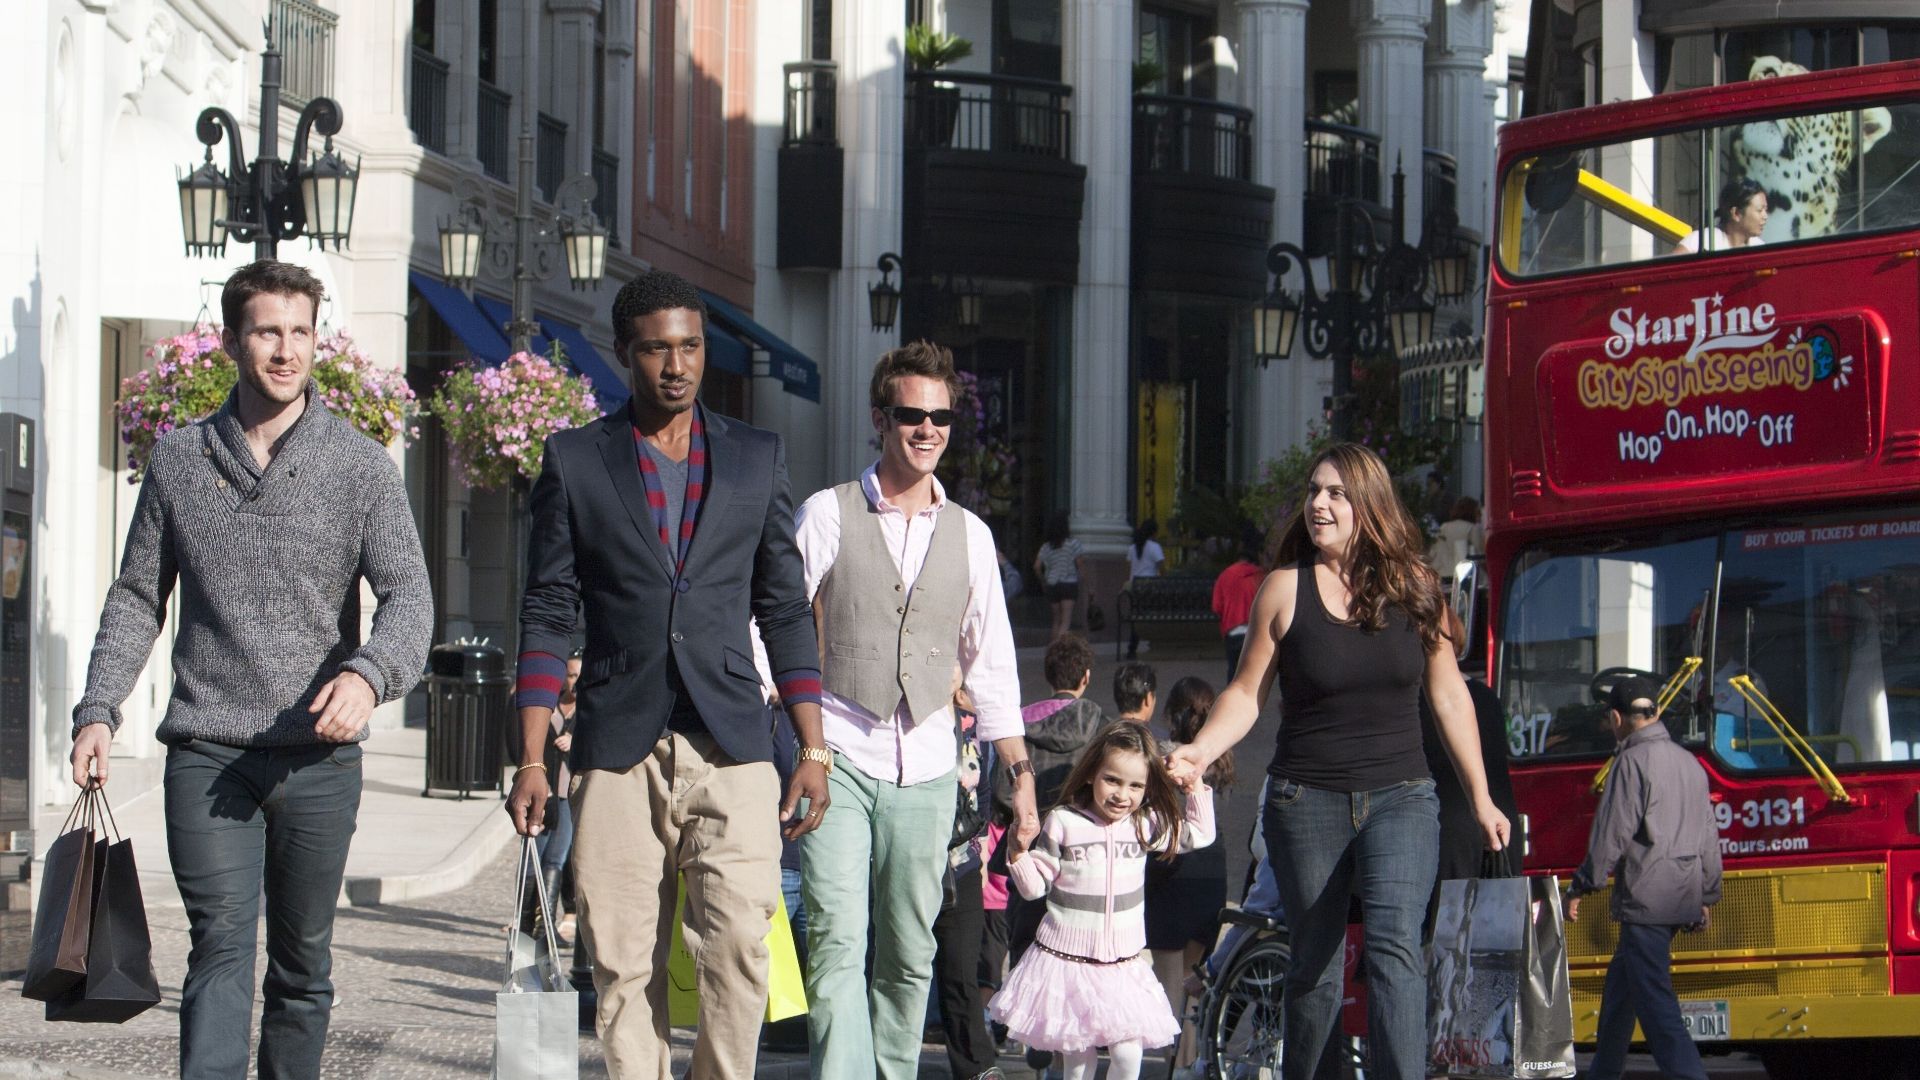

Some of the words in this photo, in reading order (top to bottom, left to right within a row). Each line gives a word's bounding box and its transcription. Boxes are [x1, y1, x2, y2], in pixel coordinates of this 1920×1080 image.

[1604, 295, 1780, 362] StarLine
[1745, 532, 1768, 547] BUY
[1774, 530, 1806, 544] YOUR
[1811, 525, 1855, 541] TICKETS
[1859, 523, 1877, 537] ON
[1510, 712, 1552, 757] 317
[1522, 1060, 1568, 1071] GUESS.com
